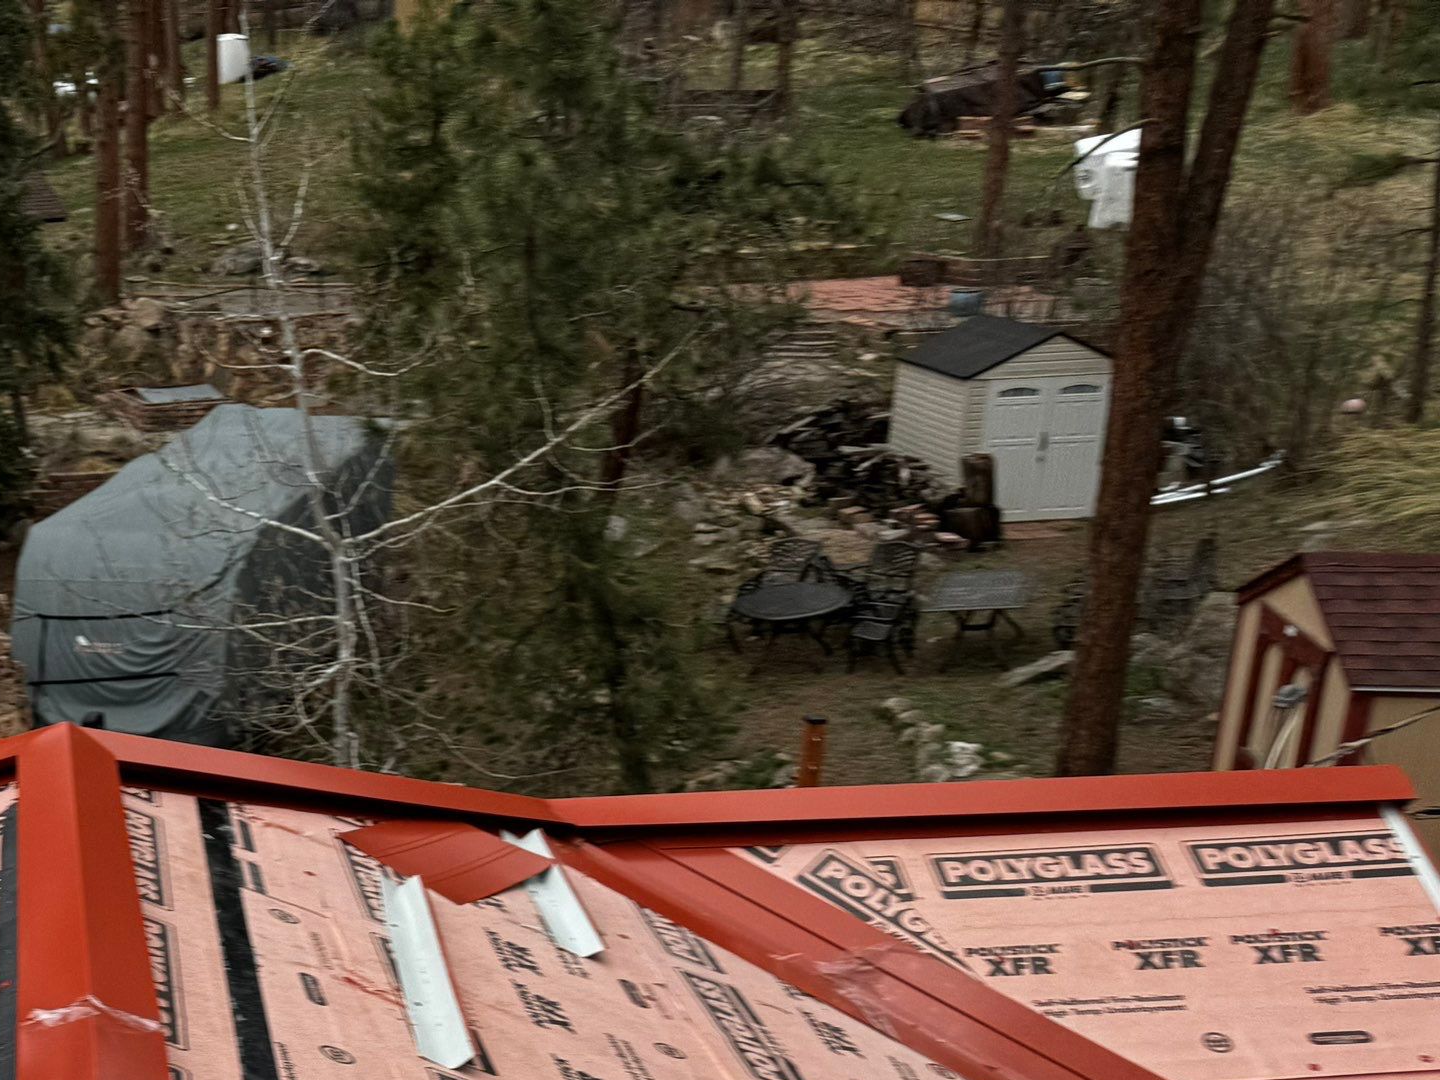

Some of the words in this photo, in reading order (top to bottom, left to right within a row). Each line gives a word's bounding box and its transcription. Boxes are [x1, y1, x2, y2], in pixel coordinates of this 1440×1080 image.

[942, 850, 1155, 883] POLYGLASS
[816, 859, 932, 933] POLYG
[1135, 949, 1205, 970] XFR
[1254, 943, 1327, 965] XFR
[984, 956, 1055, 977] XFR
